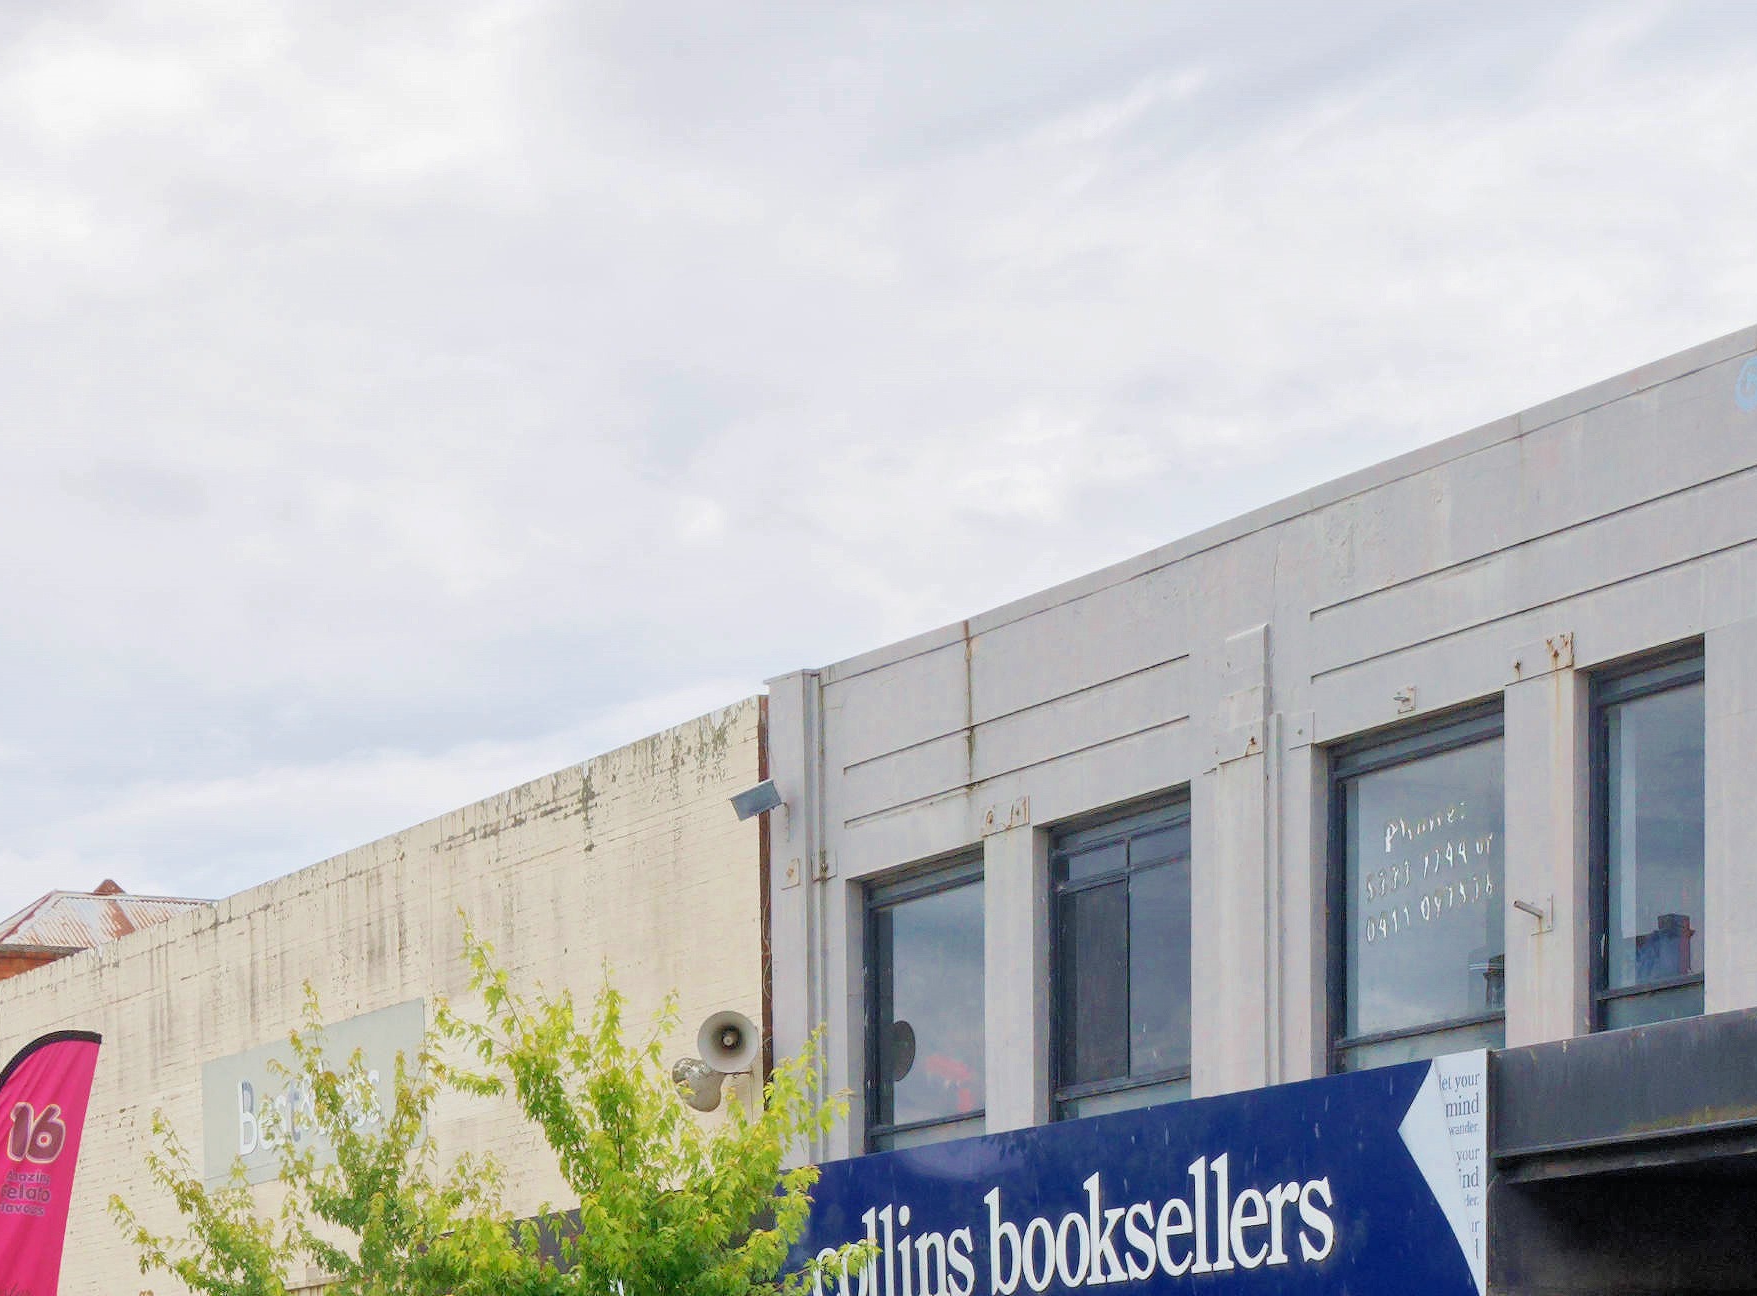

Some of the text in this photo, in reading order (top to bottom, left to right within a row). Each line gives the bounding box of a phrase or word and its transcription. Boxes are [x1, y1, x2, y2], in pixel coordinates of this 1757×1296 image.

[1454, 1071, 1481, 1092] your
[1445, 1093, 1480, 1118] mind
[7, 1101, 66, 1164] 16
[1455, 1147, 1480, 1165] your
[983, 1152, 1335, 1296] booksellers
